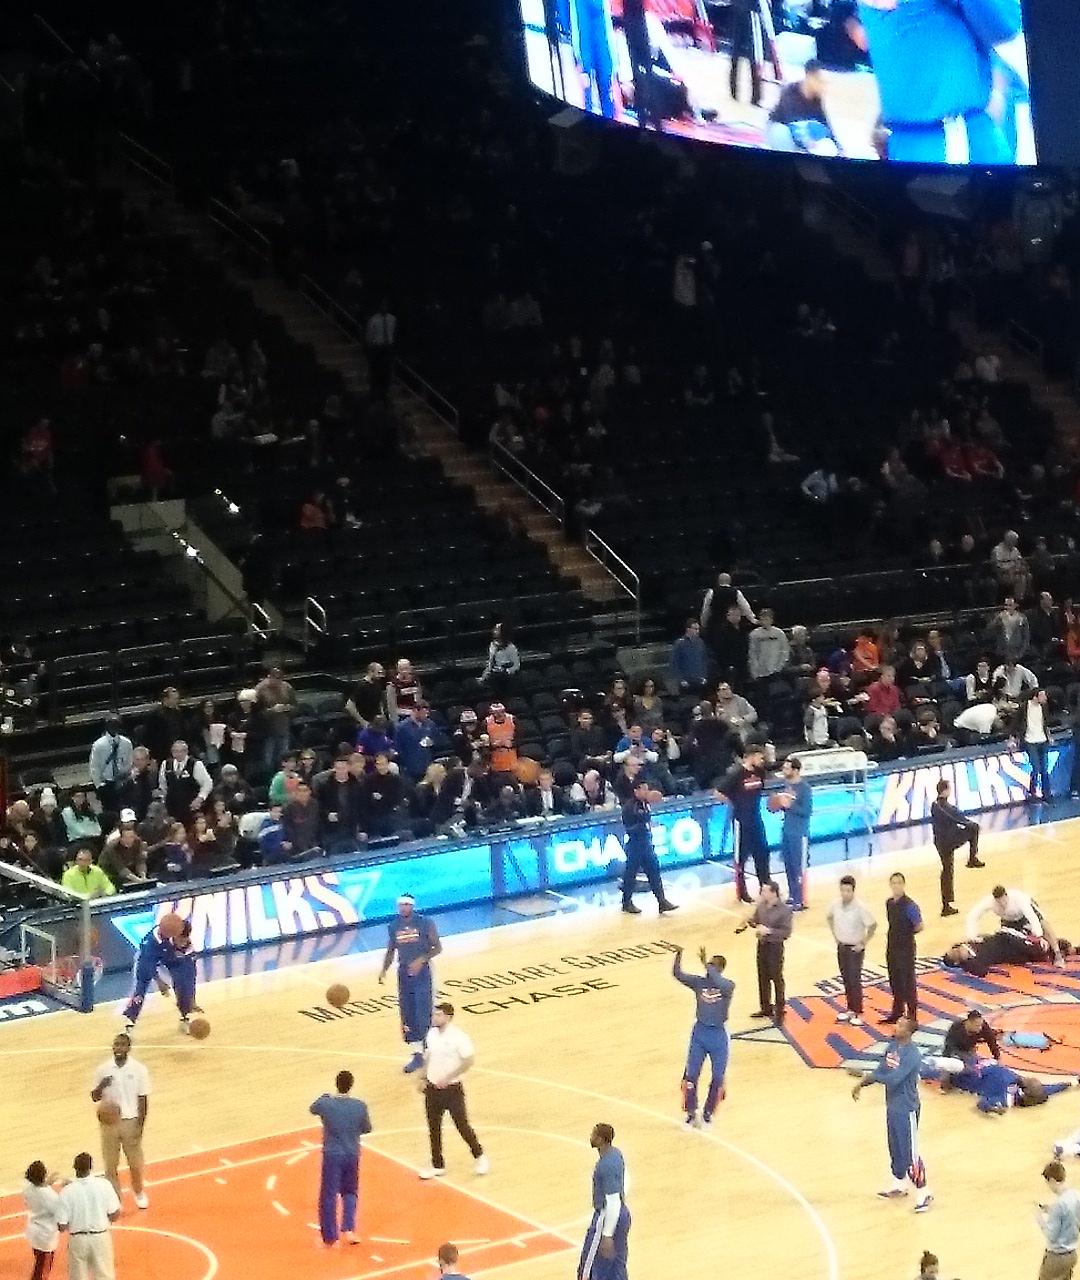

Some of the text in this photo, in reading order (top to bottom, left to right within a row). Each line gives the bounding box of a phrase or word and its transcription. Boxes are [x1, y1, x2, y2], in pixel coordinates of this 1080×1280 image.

[554, 823, 669, 871] CHAE
[298, 982, 452, 1023] MADISN
[461, 978, 620, 1016] CHASE
